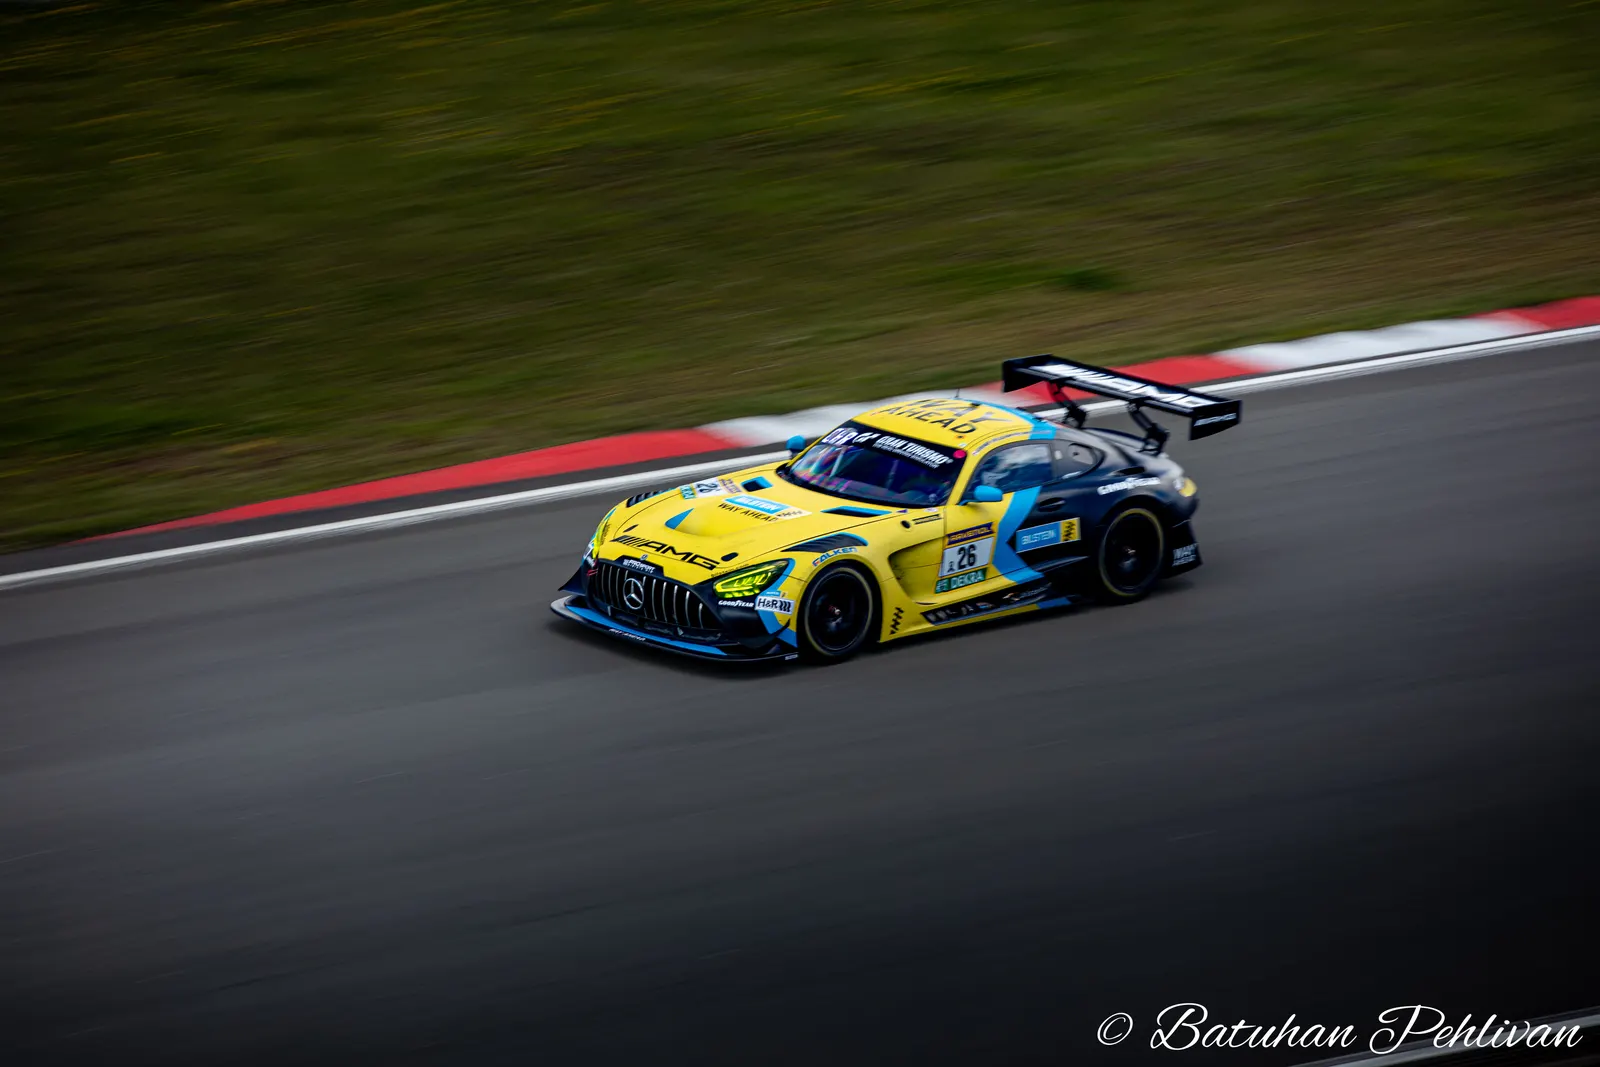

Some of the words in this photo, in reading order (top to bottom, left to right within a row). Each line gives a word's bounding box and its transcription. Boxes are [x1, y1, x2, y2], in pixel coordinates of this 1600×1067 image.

[870, 406, 976, 434] AHEAD
[876, 435, 909, 449] GRAN
[902, 442, 950, 465] TURISMO
[718, 502, 743, 513] WAY
[740, 510, 779, 522] AHEAD
[637, 541, 720, 570] AMG
[957, 544, 977, 570] 26
[951, 570, 986, 589] DEKRA
[757, 597, 778, 609] H&R
